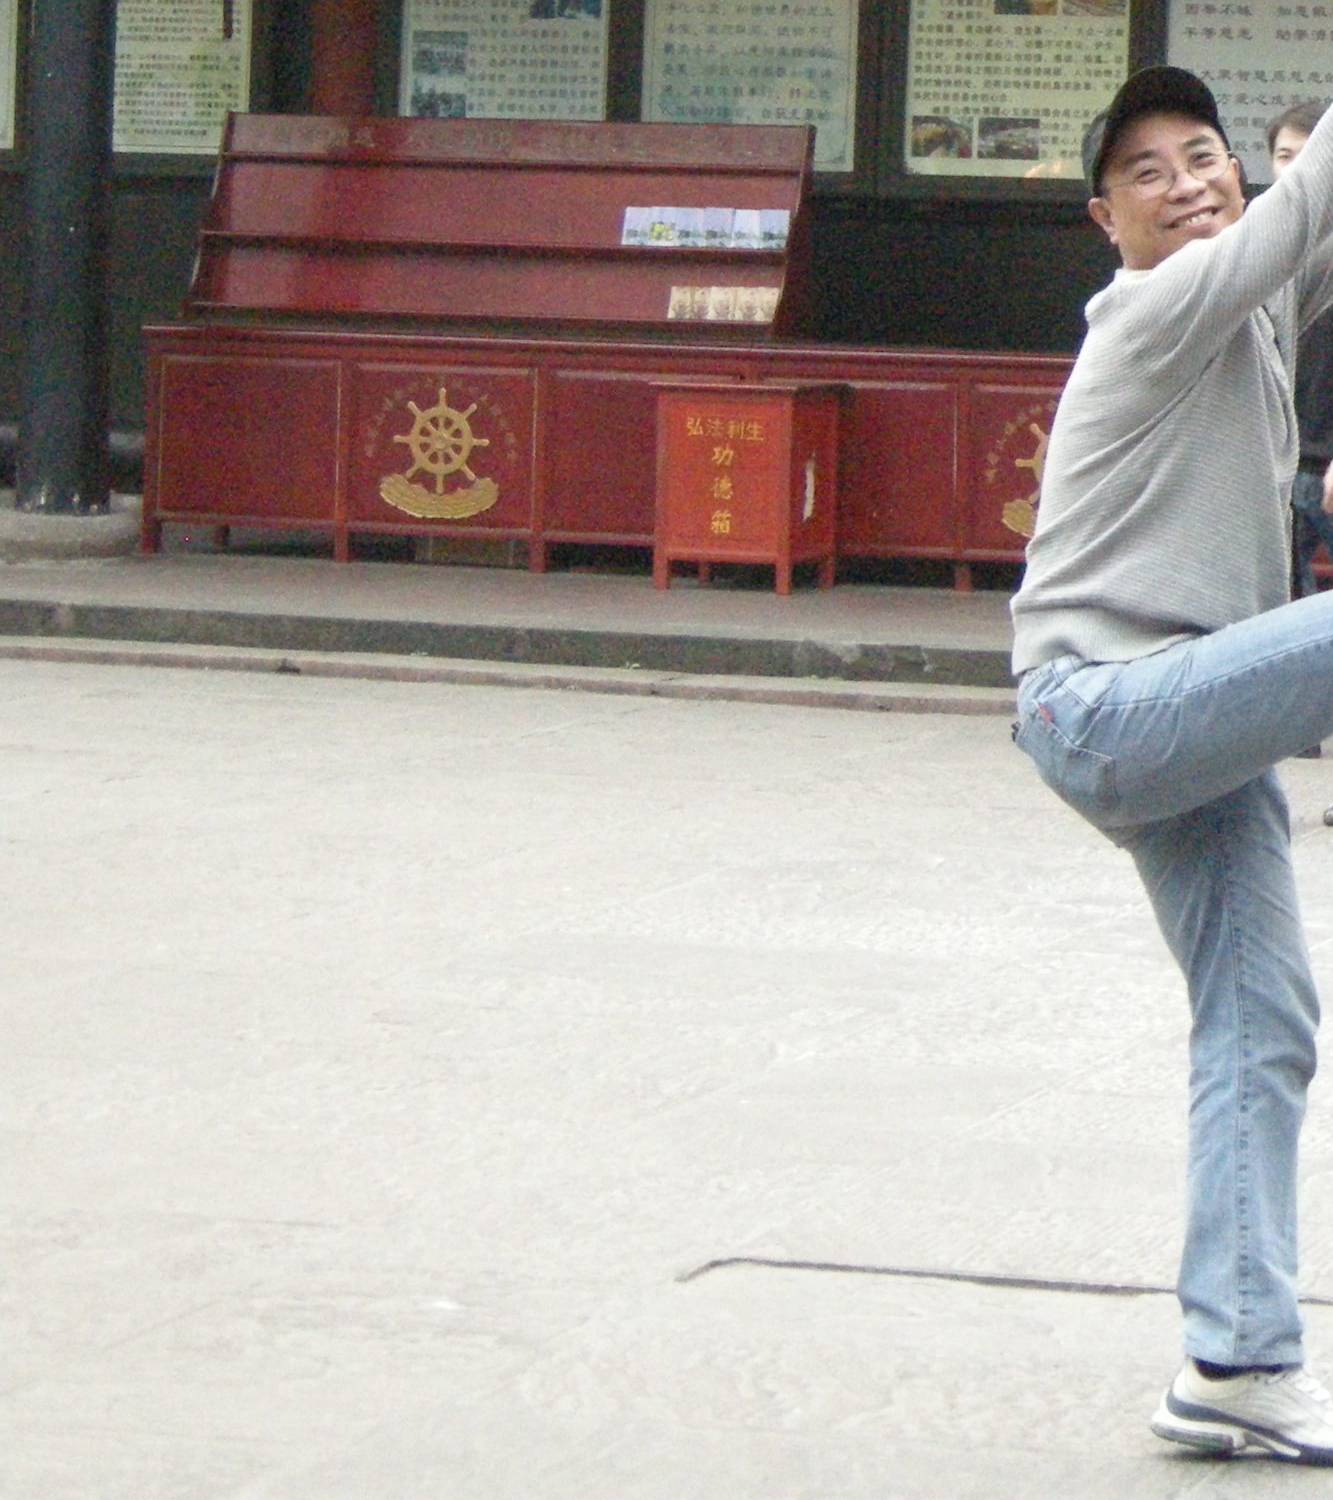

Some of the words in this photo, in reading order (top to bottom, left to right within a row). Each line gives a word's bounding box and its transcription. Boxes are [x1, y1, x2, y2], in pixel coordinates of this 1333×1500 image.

[686, 417, 765, 442] 弘法利生
[711, 443, 734, 535] 功德箱
